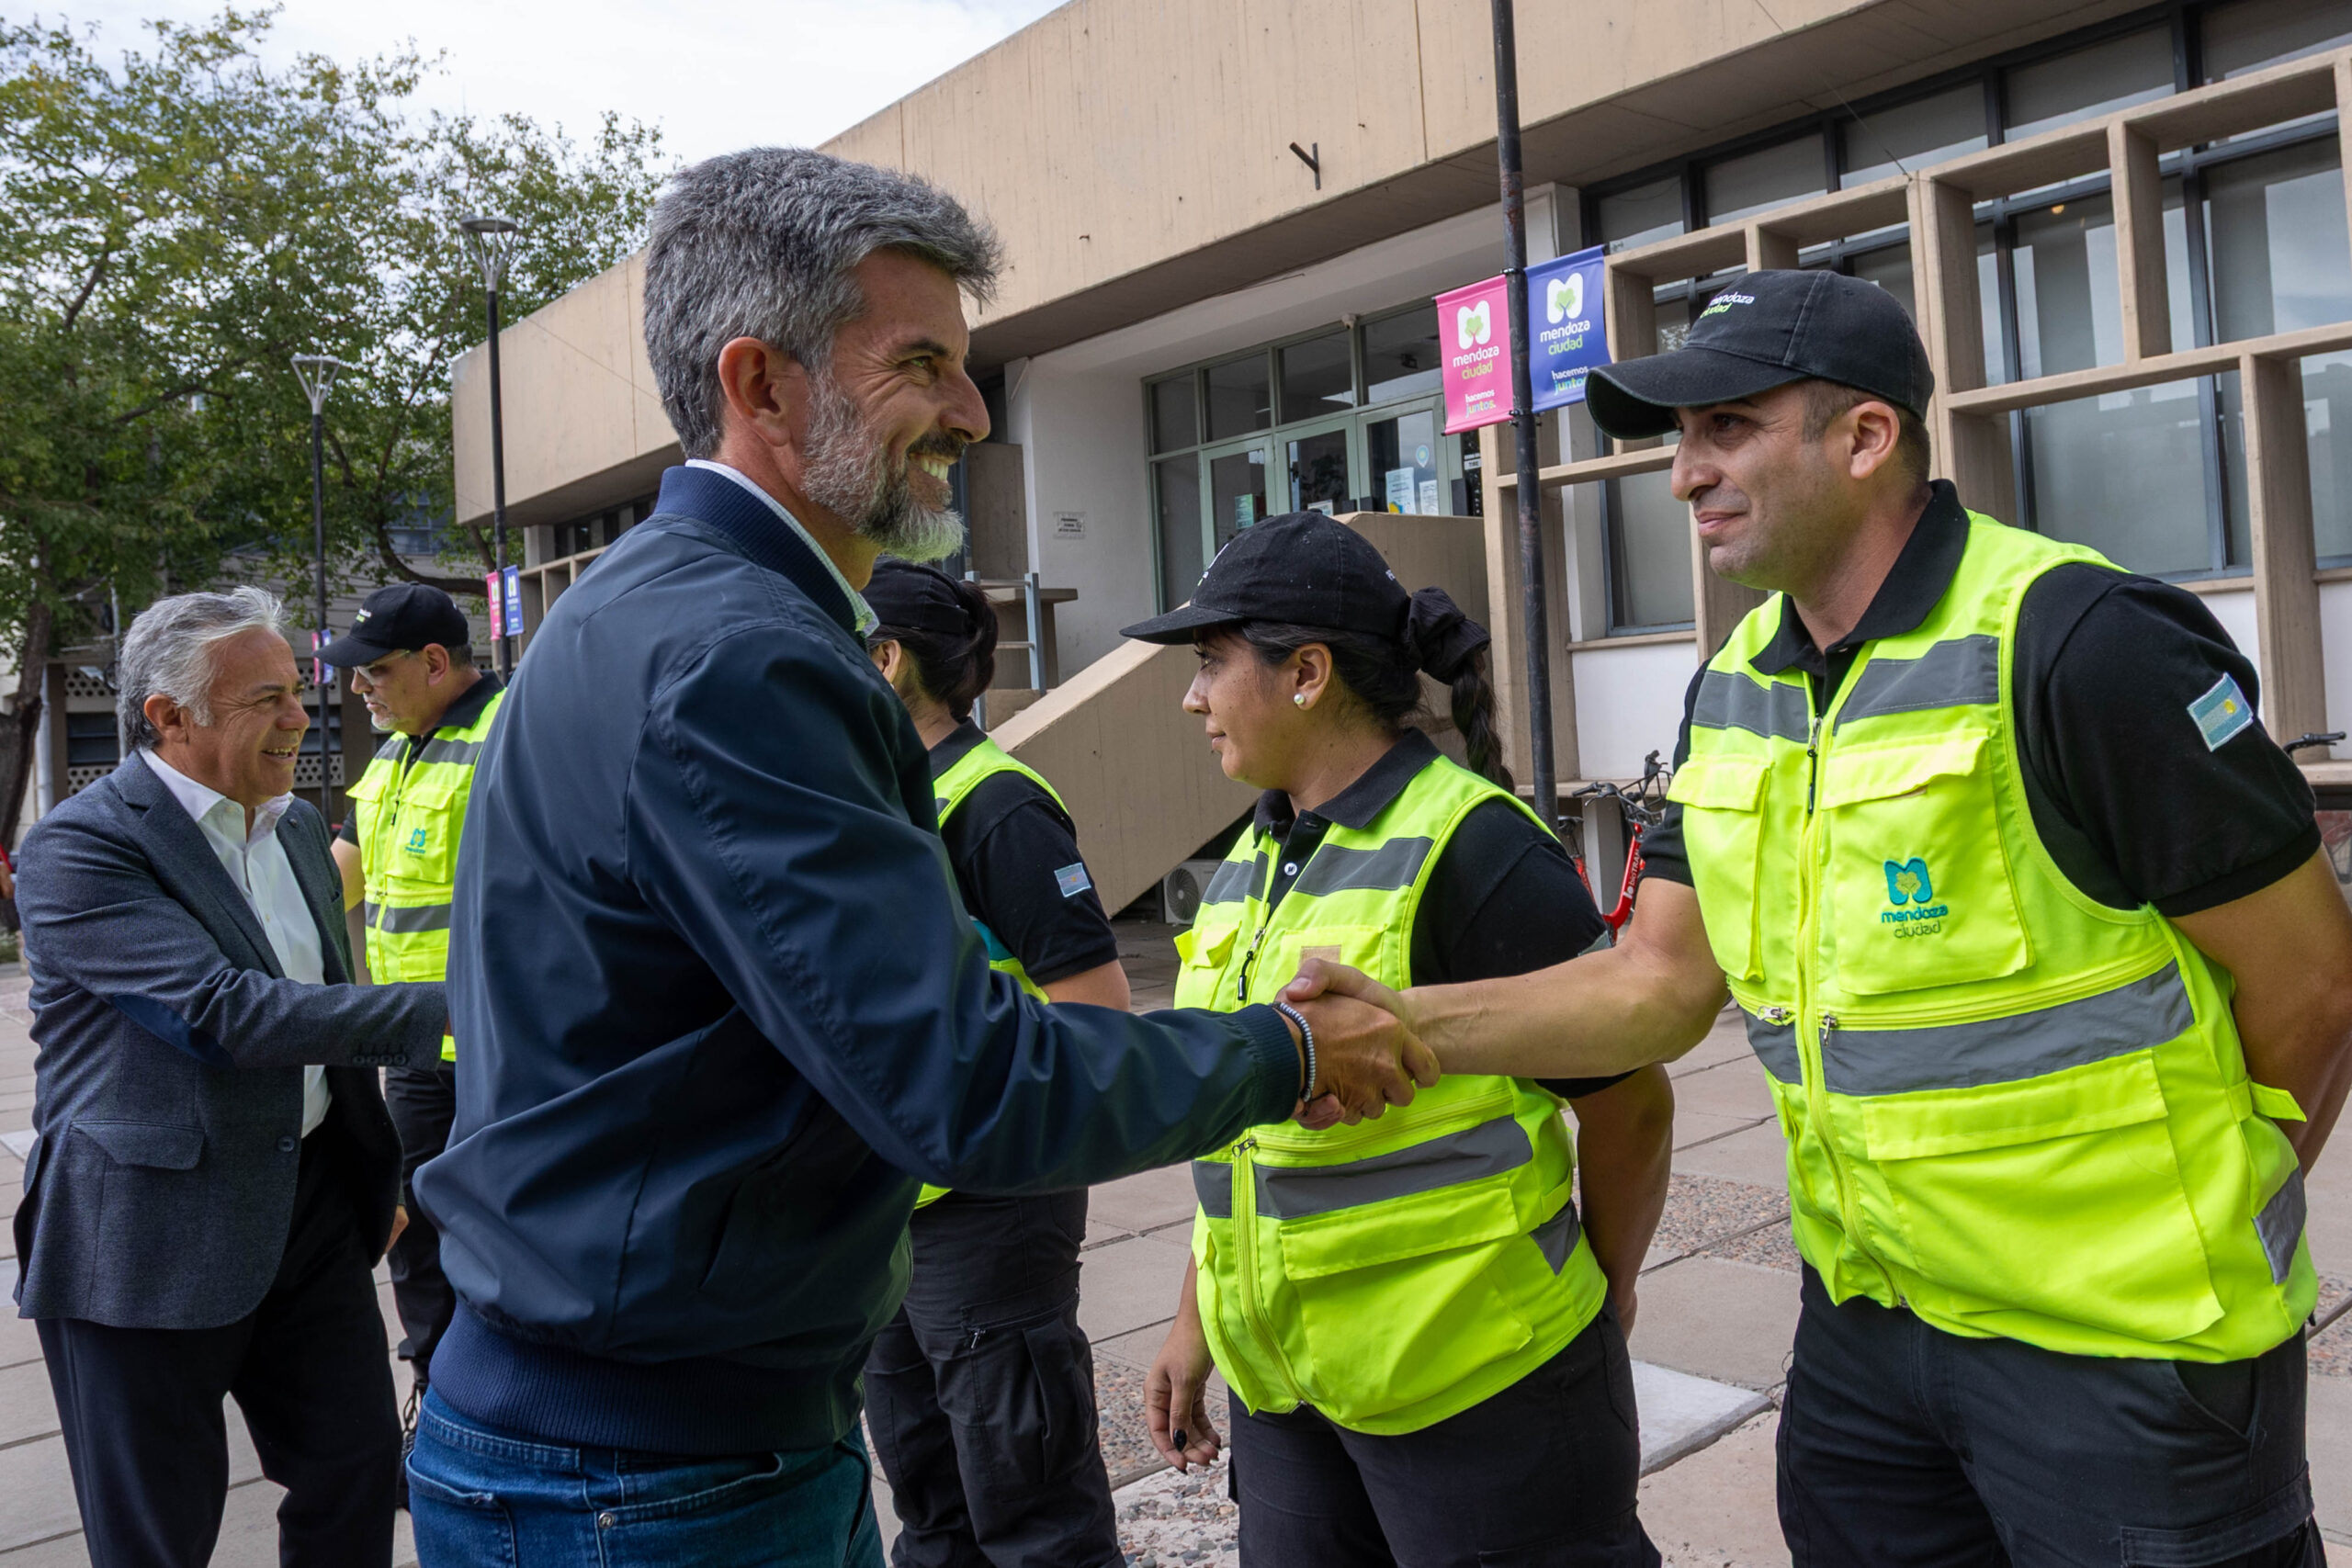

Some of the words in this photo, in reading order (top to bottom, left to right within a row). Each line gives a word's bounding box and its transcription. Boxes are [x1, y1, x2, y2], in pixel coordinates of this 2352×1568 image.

[1540, 320, 1590, 343] mendoza
[1548, 335, 1583, 355] ciudad
[1453, 346, 1499, 367] mendoza
[1462, 361, 1493, 380] ciudad
[1551, 367, 1589, 380] hacemos
[1464, 389, 1495, 403] hacemos
[1882, 904, 1949, 923] mendoza
[1894, 919, 1941, 939] ciudad
